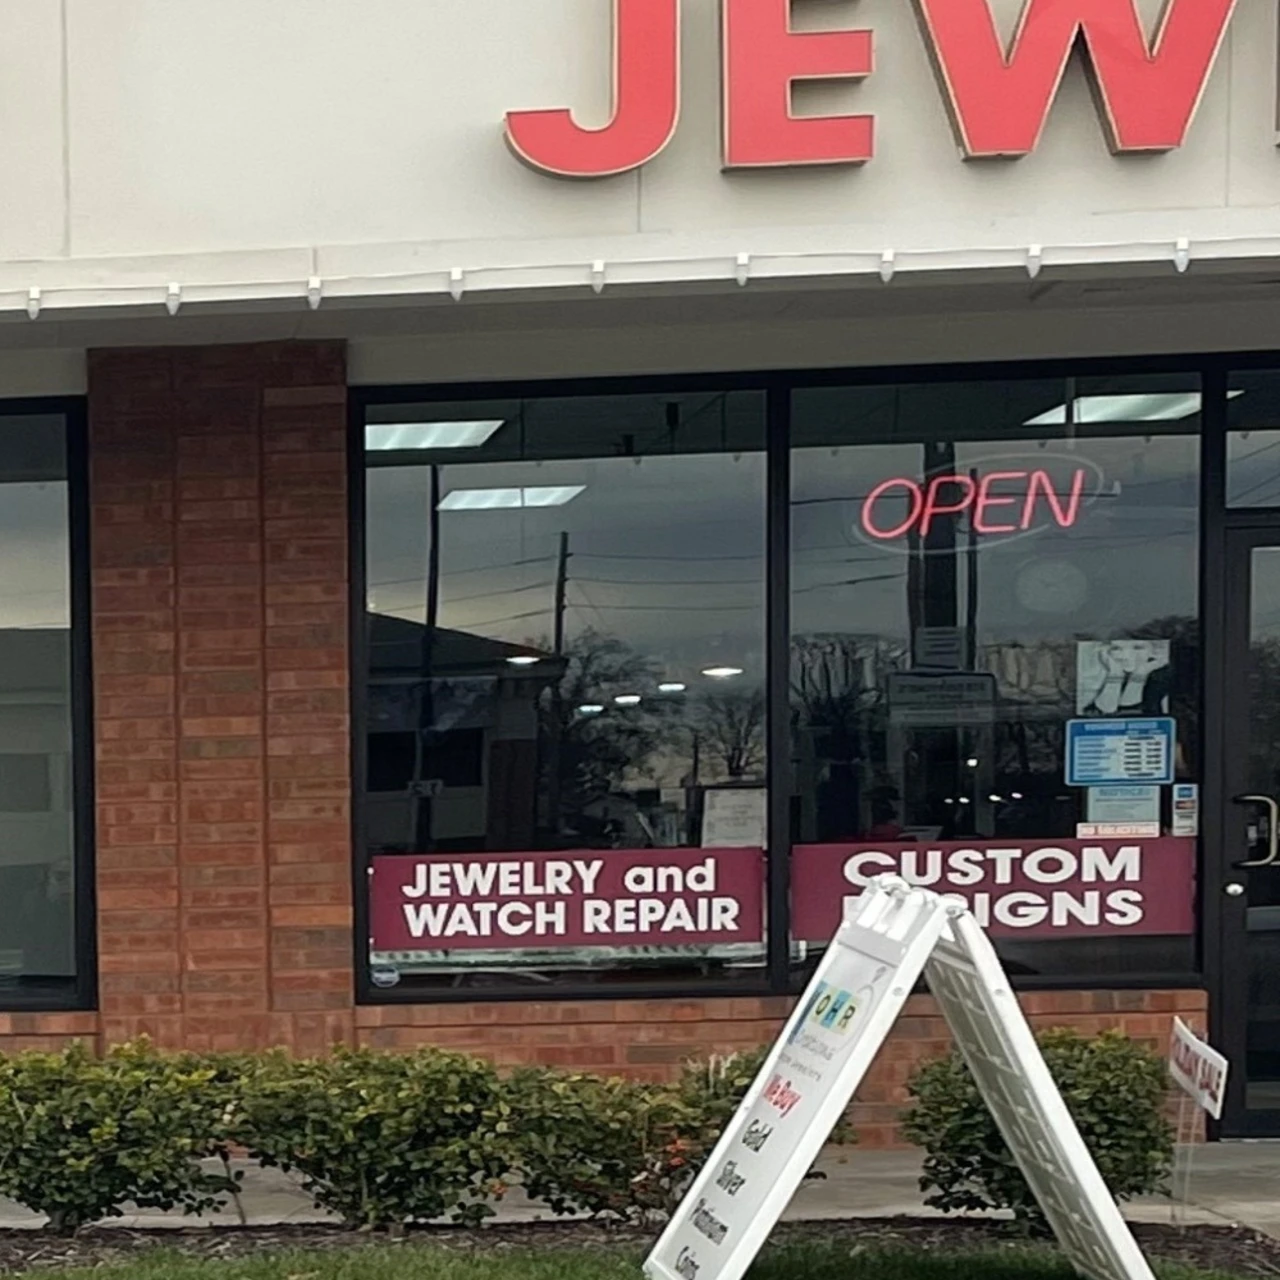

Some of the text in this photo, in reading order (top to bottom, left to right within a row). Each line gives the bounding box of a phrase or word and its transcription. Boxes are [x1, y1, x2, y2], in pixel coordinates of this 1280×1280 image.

[503, 0, 1280, 177] JEW
[860, 469, 1085, 539] OPEN
[402, 858, 716, 898] JEWELRY and
[843, 846, 1140, 886] CUSTOM
[403, 897, 739, 937] WATCH REPAIR
[843, 889, 1143, 927] IGNS
